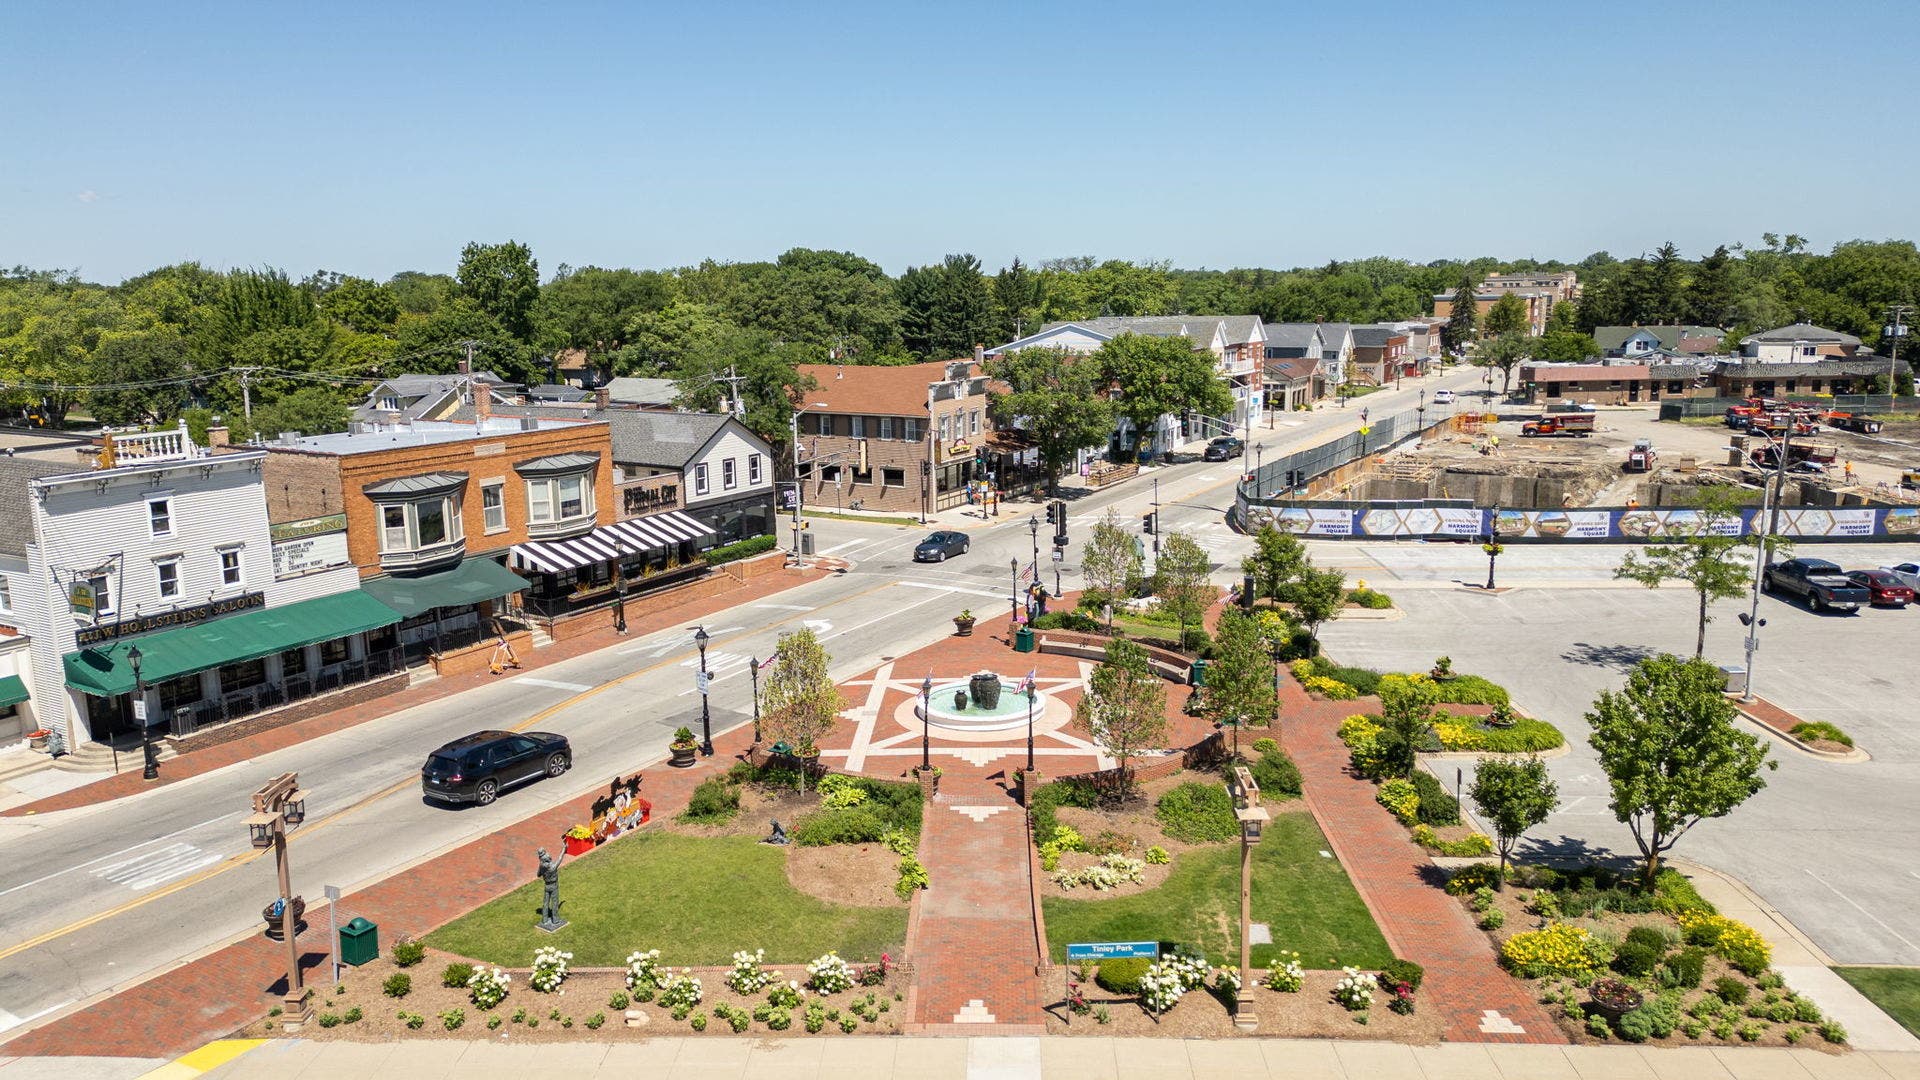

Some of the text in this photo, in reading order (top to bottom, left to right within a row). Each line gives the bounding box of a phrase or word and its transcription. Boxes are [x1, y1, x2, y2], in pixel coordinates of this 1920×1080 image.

[212, 594, 264, 614] SALOON
[89, 843, 223, 890] ONLY
[1092, 945, 1114, 953] Tinley
